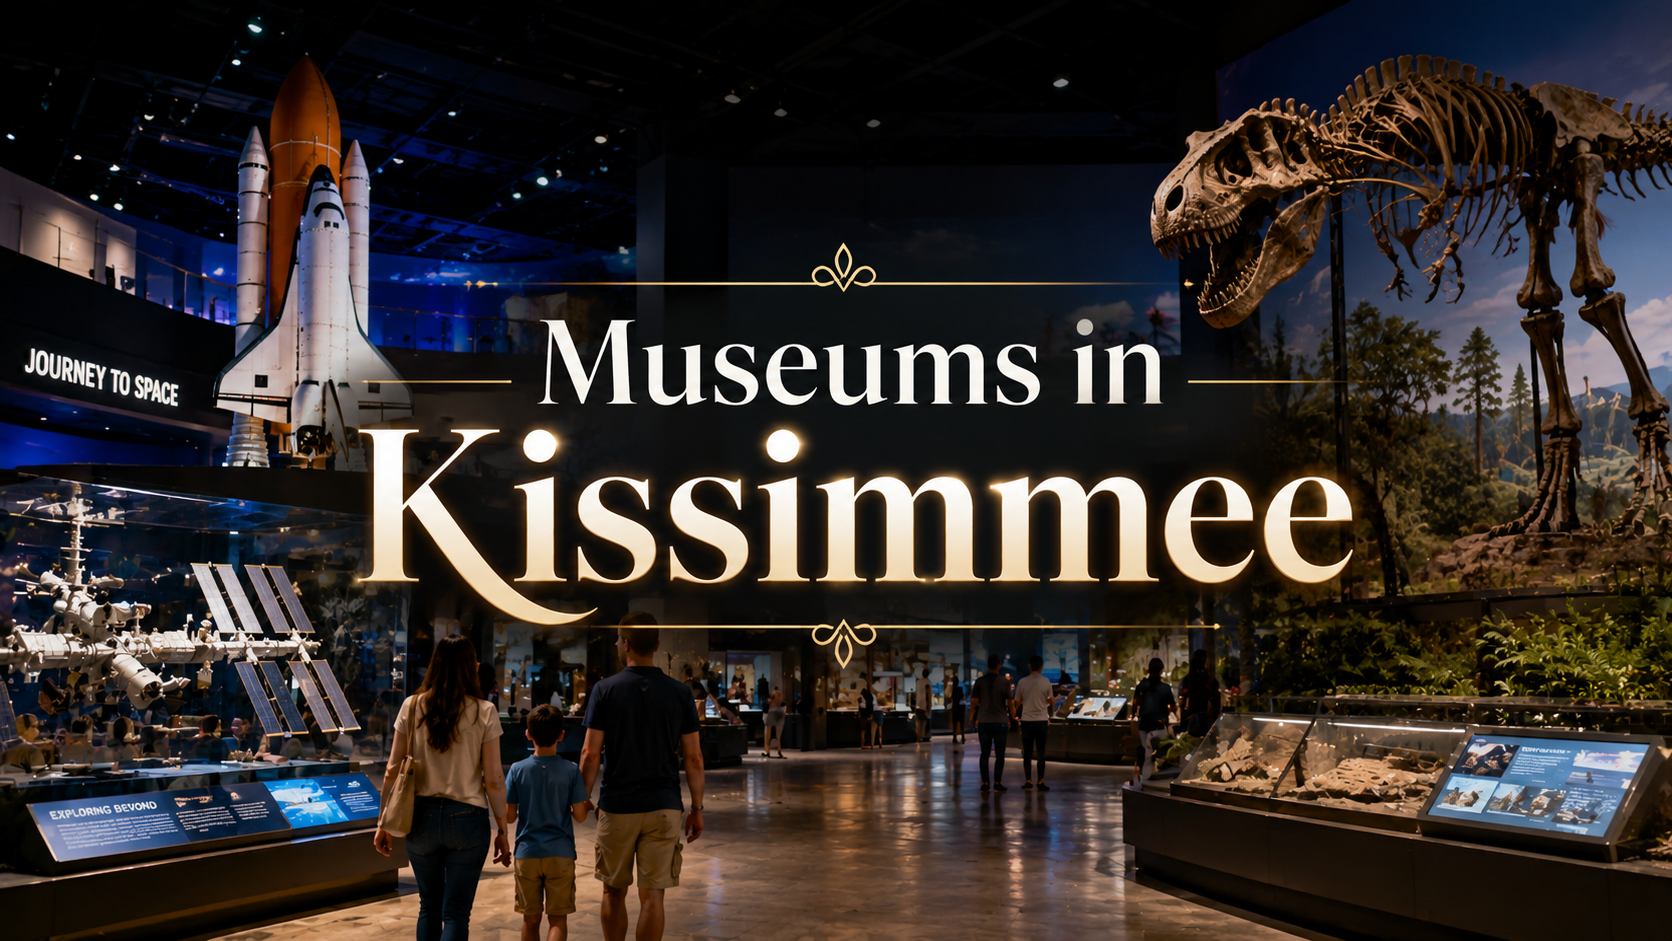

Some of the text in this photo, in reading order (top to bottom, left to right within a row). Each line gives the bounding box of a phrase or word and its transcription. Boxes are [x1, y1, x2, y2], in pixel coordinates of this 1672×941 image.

[24, 347, 179, 407] JOURNEY TO SPACE
[49, 805, 112, 820] EXPLORING
